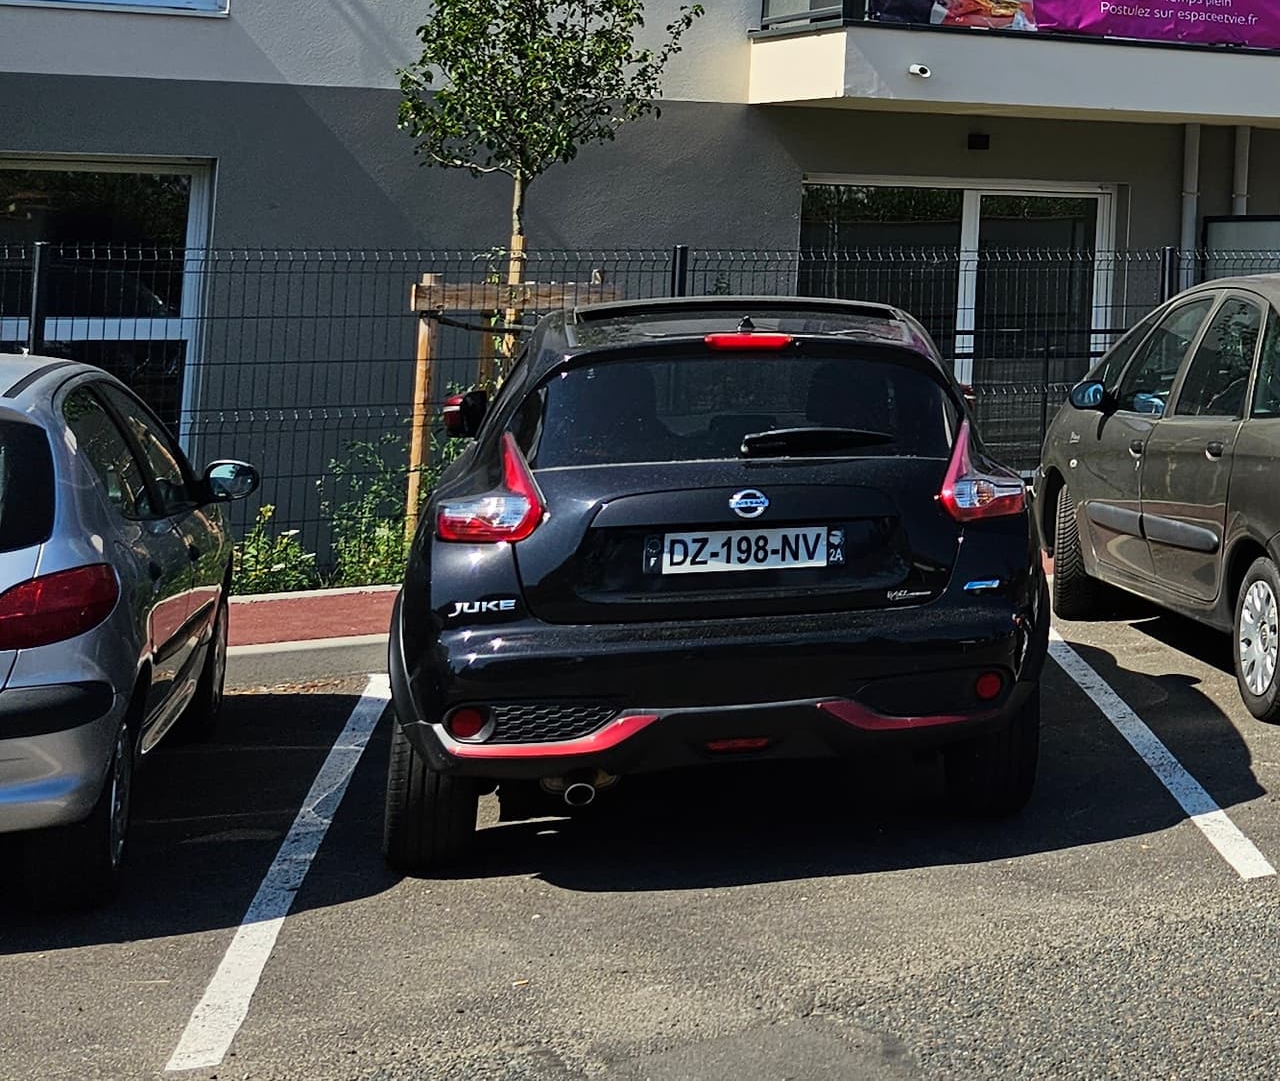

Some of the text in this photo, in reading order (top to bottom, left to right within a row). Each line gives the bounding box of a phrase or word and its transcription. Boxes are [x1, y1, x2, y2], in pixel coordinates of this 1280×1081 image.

[1100, 1, 1259, 25] Postulez sur espaceetvie.fr
[669, 532, 822, 567] DZ-198-NV
[829, 547, 844, 562] 2A
[448, 599, 517, 617] JUKE
